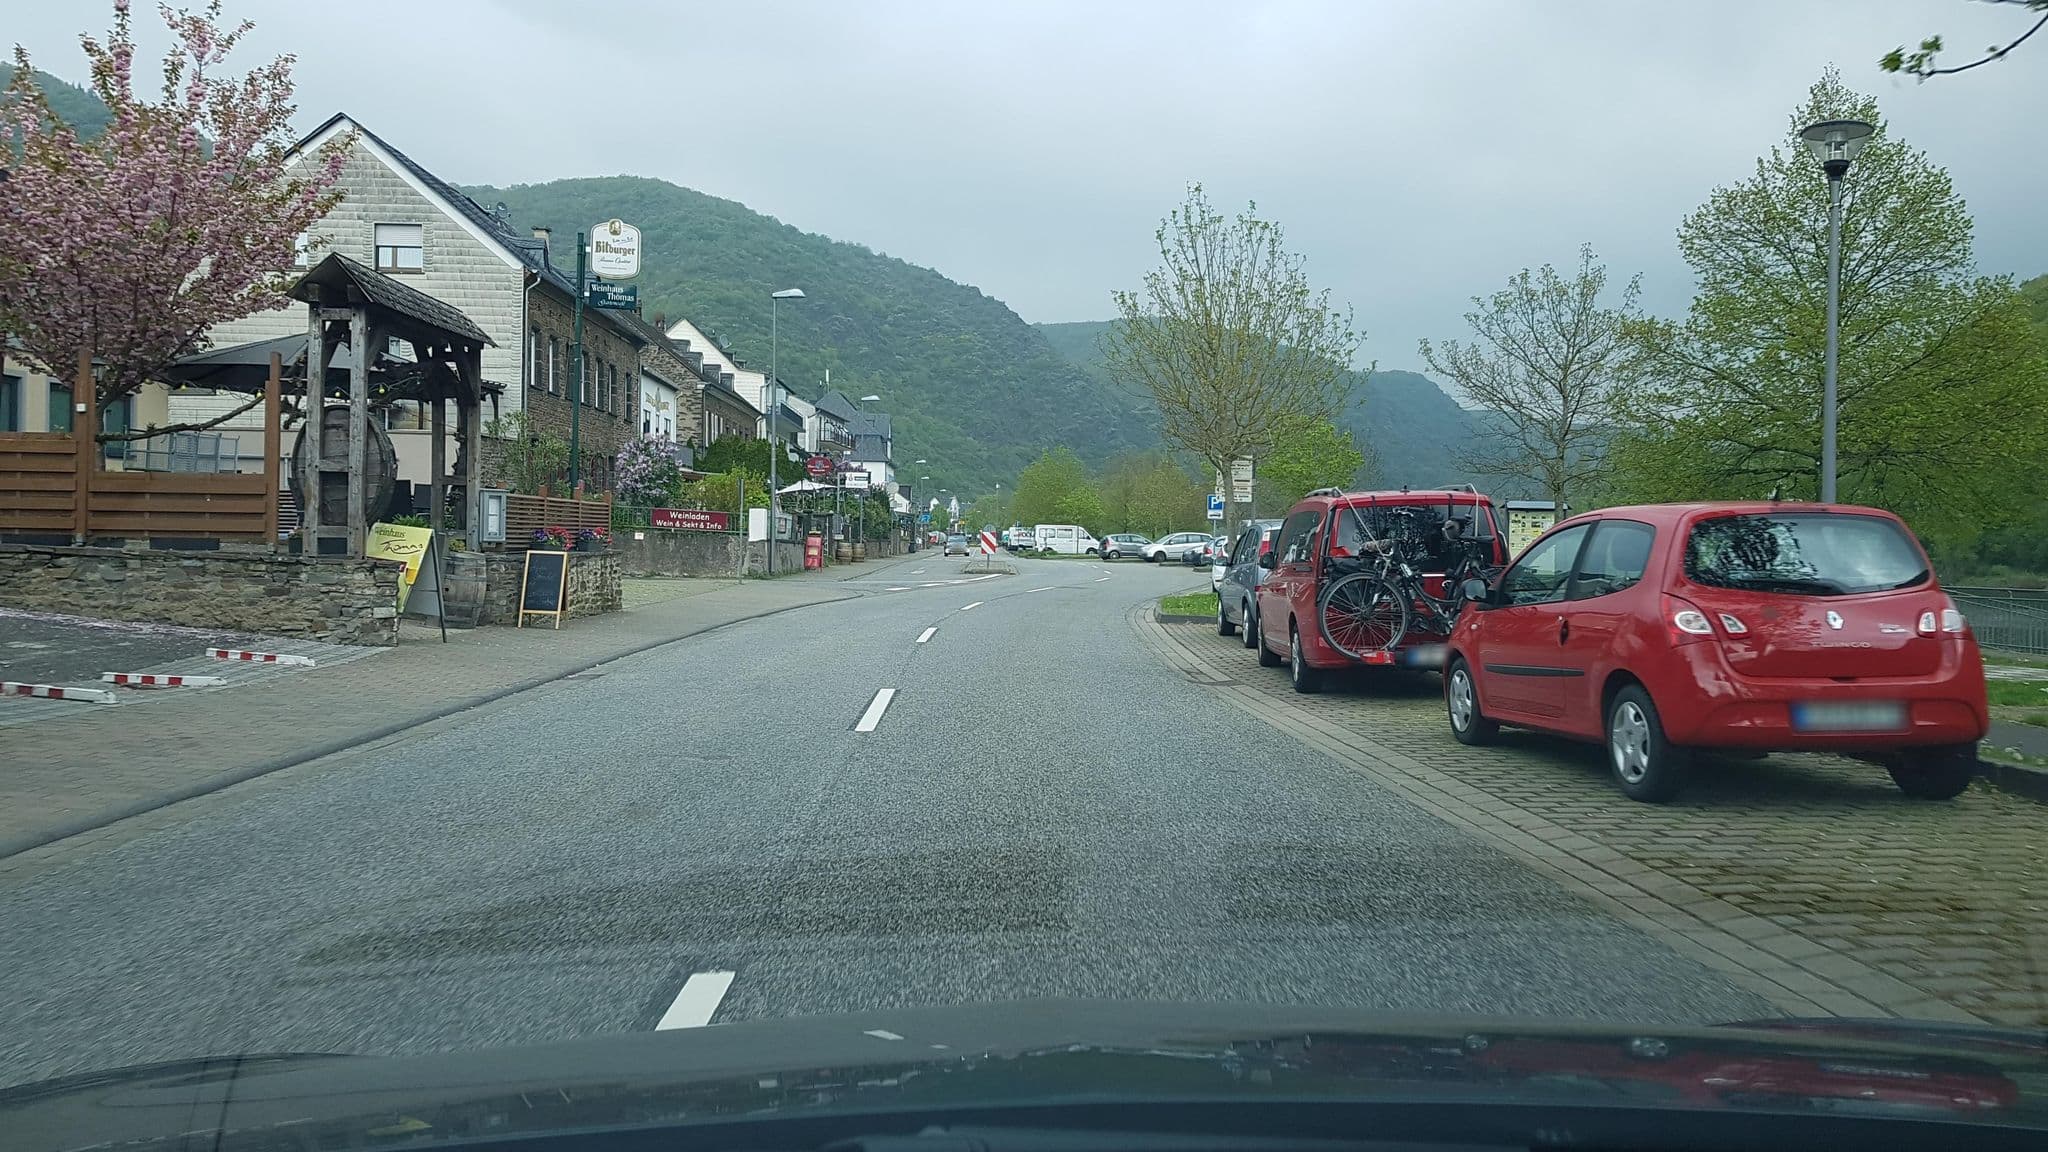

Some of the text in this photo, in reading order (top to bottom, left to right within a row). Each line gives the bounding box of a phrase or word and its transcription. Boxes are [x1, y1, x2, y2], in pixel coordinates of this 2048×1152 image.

[595, 241, 636, 256] Bitburger
[591, 284, 624, 293] Weinhaus
[607, 293, 635, 302] Thomas
[669, 511, 710, 521] Weinladen
[706, 522, 722, 530] Info
